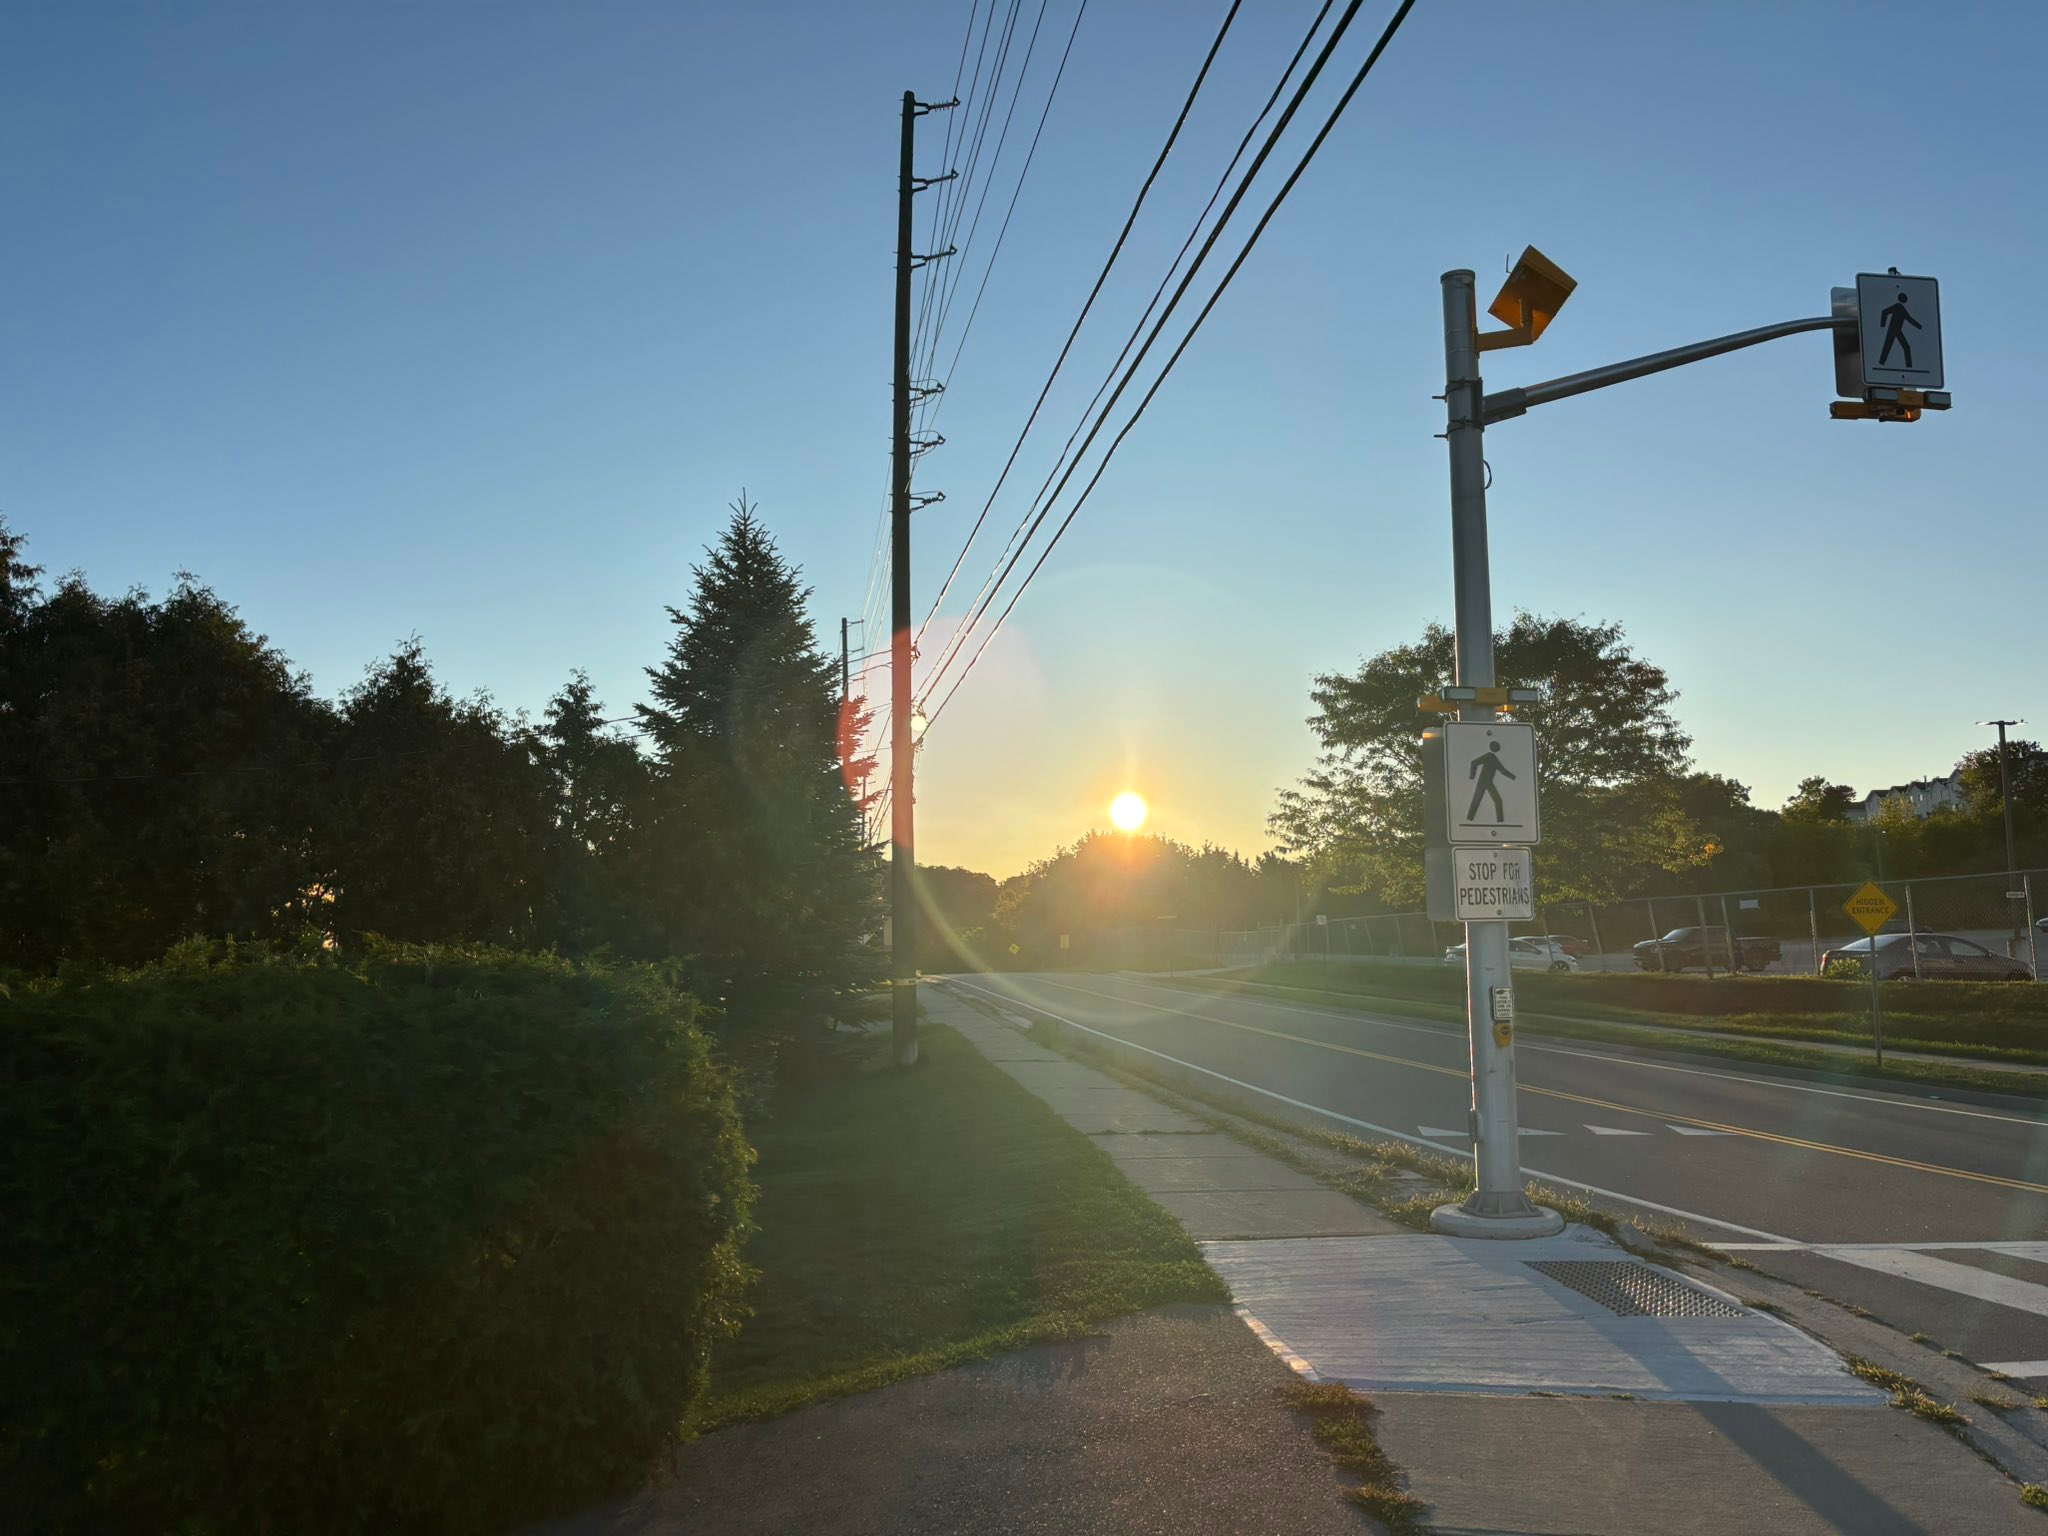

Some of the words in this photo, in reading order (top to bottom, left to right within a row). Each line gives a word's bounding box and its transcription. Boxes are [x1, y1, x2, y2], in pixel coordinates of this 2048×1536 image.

[1469, 862, 1497, 880] STOP
[1503, 862, 1521, 880] FOR
[1460, 887, 1530, 906] PEDESTRIANS
[1856, 897, 1885, 905] HIDDEN
[1852, 906, 1889, 914] ENTRANCE
